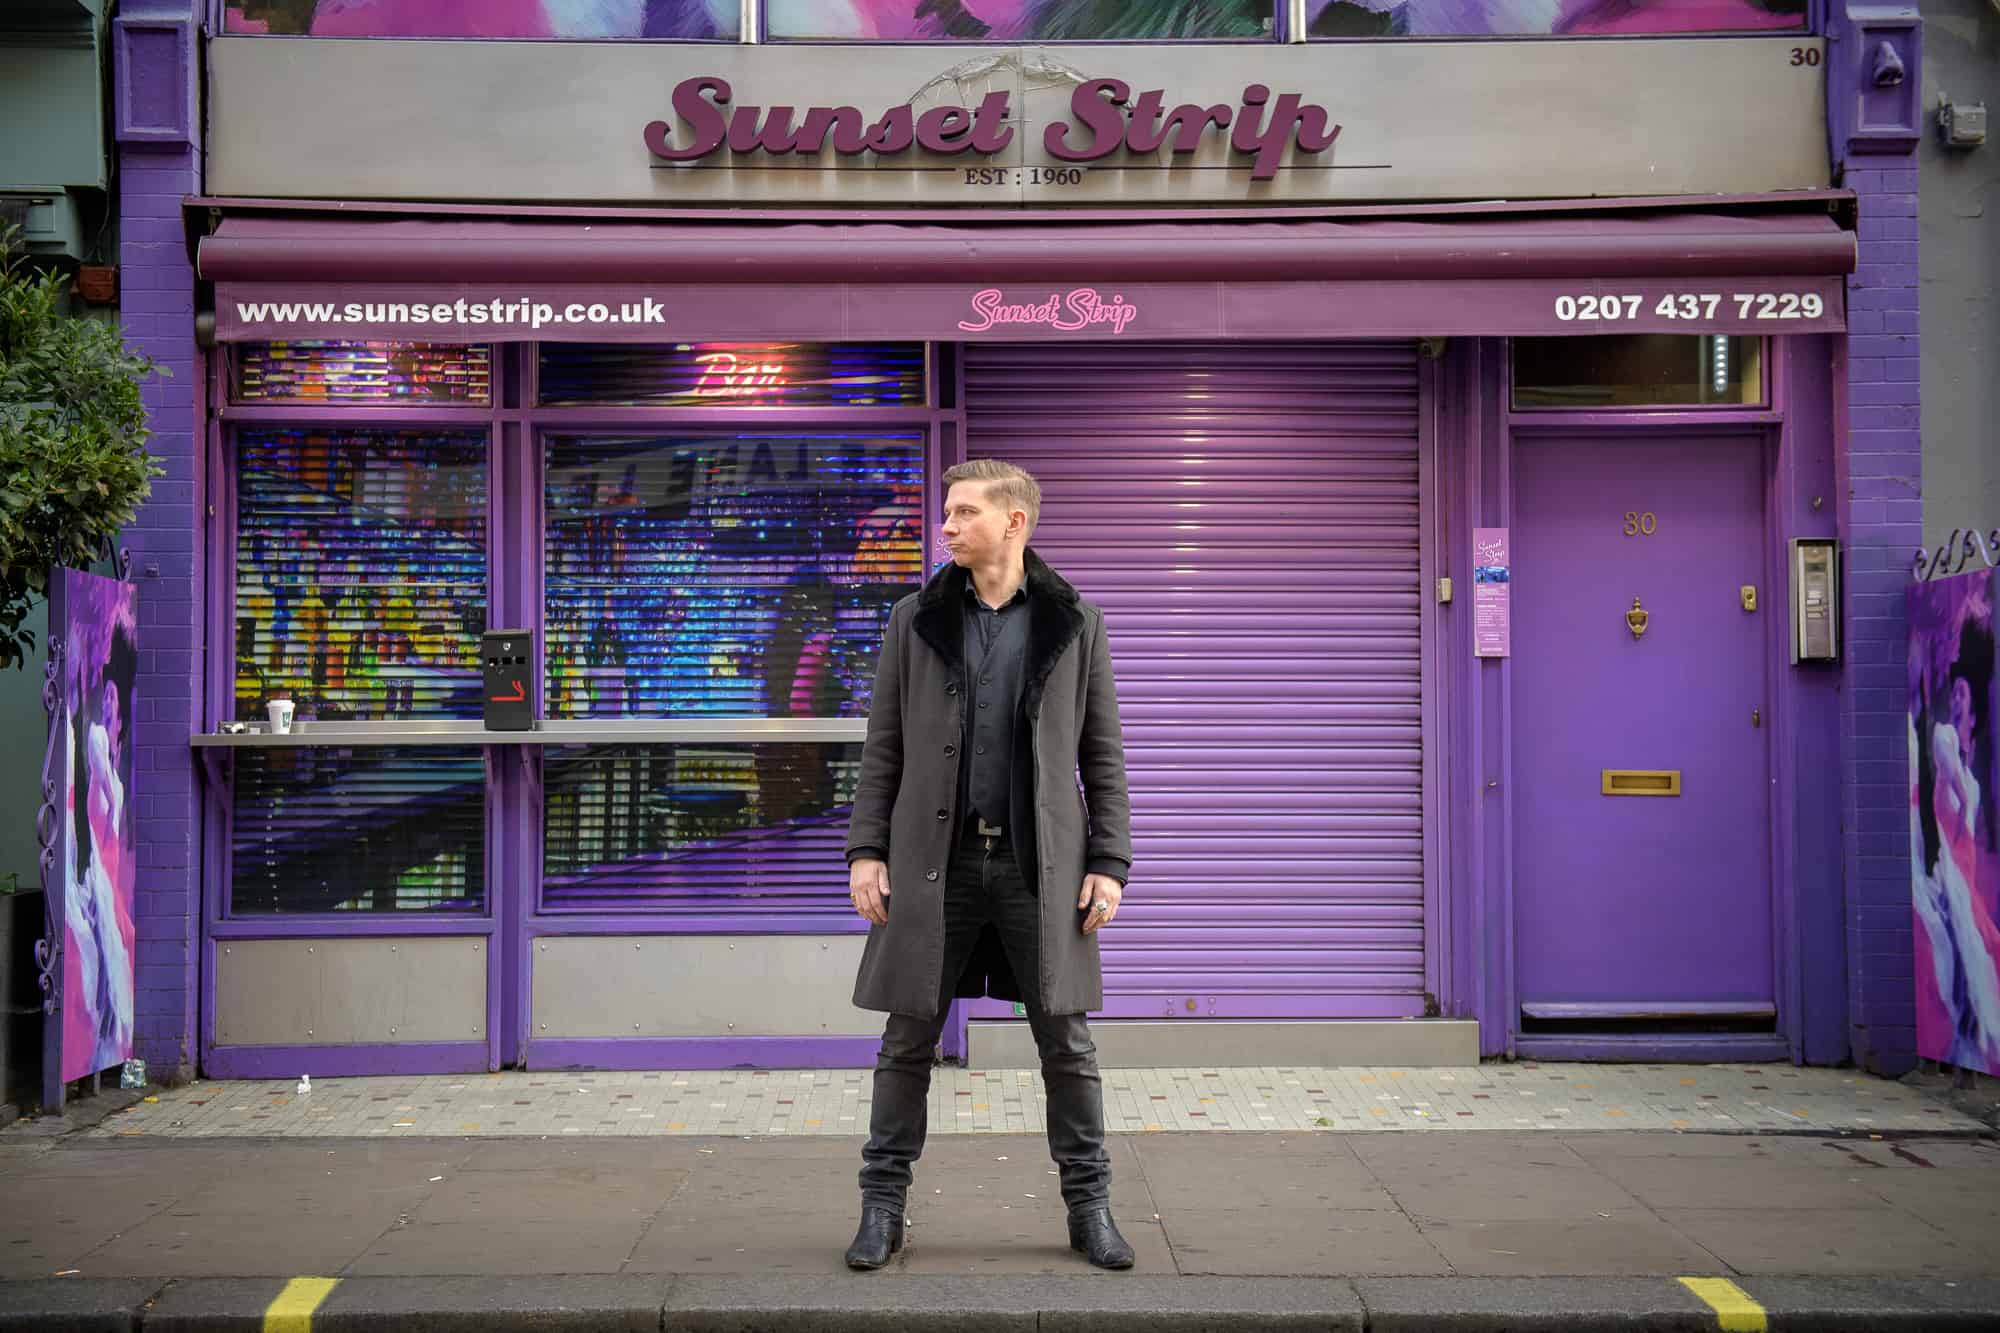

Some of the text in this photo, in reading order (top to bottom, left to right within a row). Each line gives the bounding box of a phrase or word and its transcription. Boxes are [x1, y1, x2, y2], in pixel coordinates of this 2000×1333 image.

[1790, 46, 1821, 67] 30
[643, 76, 1342, 181] Sunset Strip
[964, 167, 1008, 185] EST
[1029, 167, 1082, 186] 1960
[236, 296, 666, 329] www.sunsetstrip.co.uk
[958, 288, 1137, 334] Sunset Strip
[1554, 293, 1824, 320] 0207 437 7229
[1623, 511, 1657, 537] 30
